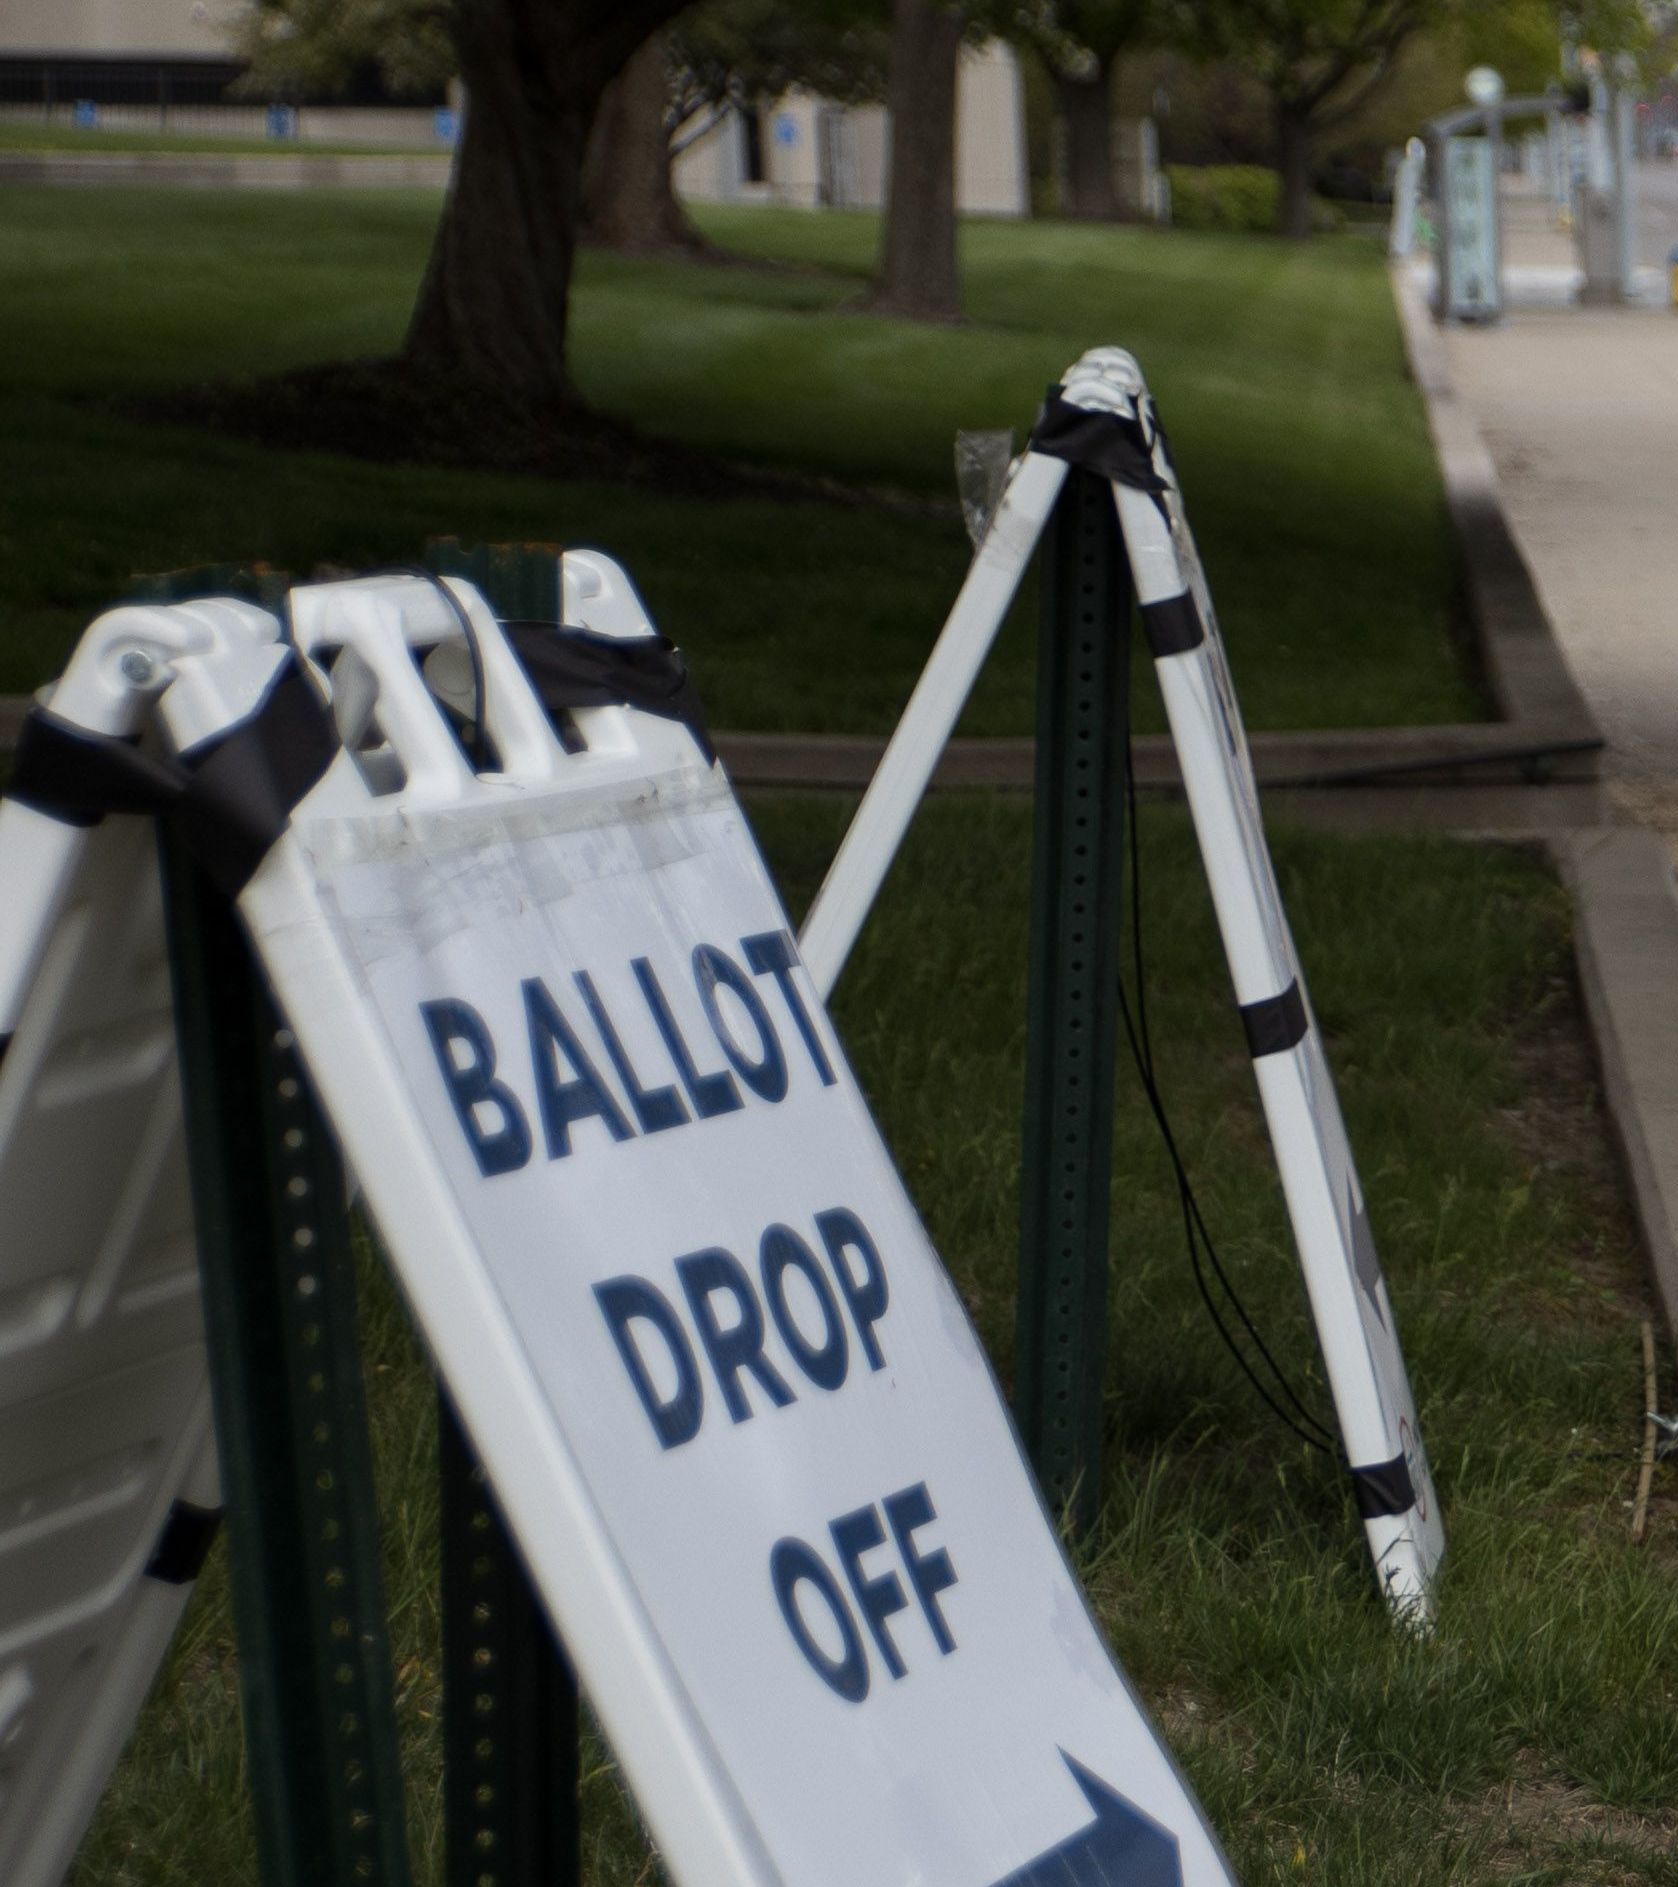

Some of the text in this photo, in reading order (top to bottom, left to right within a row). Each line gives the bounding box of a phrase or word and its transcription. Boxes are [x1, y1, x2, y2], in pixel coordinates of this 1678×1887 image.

[420, 928, 839, 1179] BALLOT
[591, 1206, 890, 1451] DROP
[770, 1481, 959, 1703] OFF
